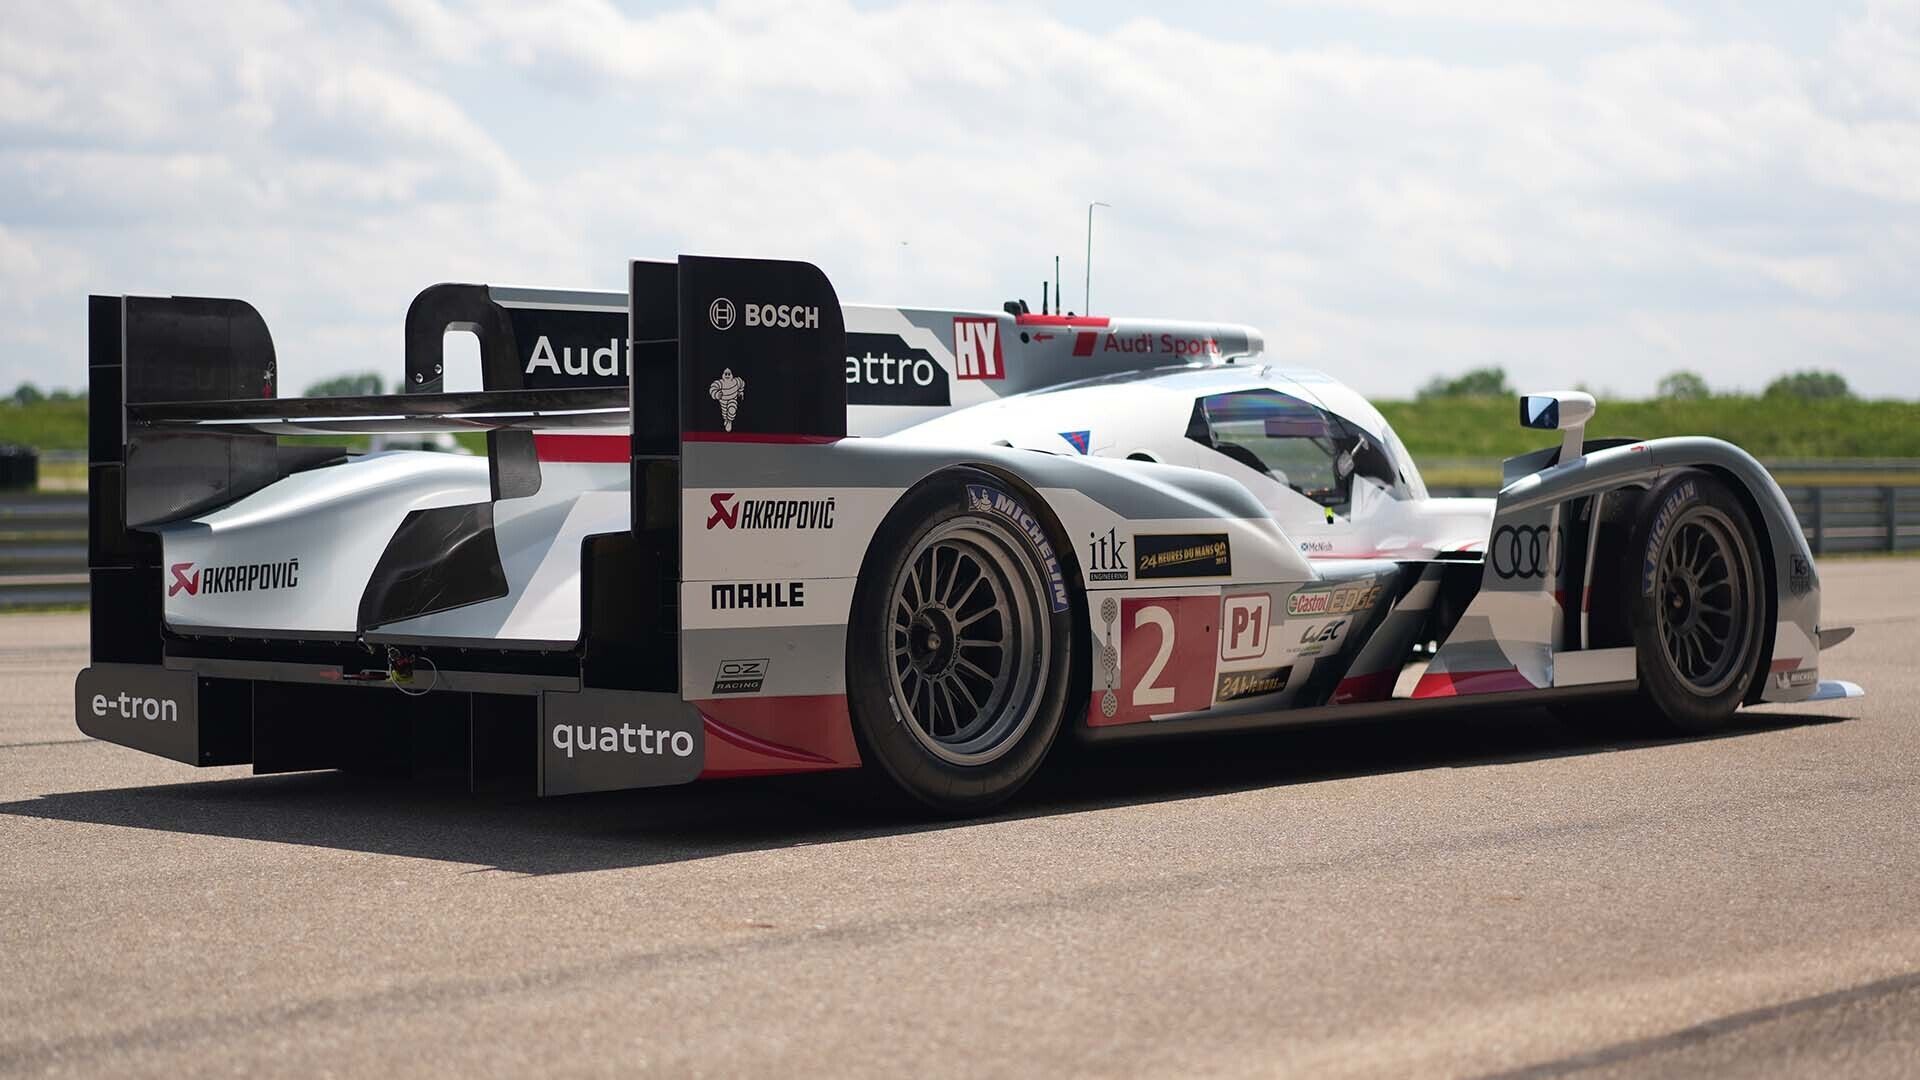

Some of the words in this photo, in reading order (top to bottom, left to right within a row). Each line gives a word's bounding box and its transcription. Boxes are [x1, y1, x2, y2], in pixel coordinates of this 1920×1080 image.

[745, 304, 819, 329] BOSCH
[525, 336, 630, 377] Audi
[954, 322, 996, 376] HY
[1104, 331, 1153, 353] Audi
[1160, 334, 1219, 356] Sport
[1646, 480, 1696, 566] MICHELIN
[994, 493, 1067, 605] MICHELIN
[1089, 526, 1128, 570] itk
[1140, 554, 1157, 570] 24
[1158, 549, 1183, 564] HEURES
[1183, 546, 1194, 559] DU
[1194, 543, 1214, 558] MANS
[1090, 572, 1128, 580] ENGINEERING
[712, 583, 804, 609] MAHLE
[1296, 594, 1328, 612] Castrol
[1328, 585, 1383, 613] EDGE
[1230, 606, 1263, 649] P1
[1300, 620, 1346, 644] WEC
[1133, 606, 1175, 705] 2
[716, 681, 758, 689] RACING
[92, 692, 177, 721] e-tron
[552, 723, 694, 758] quattro
